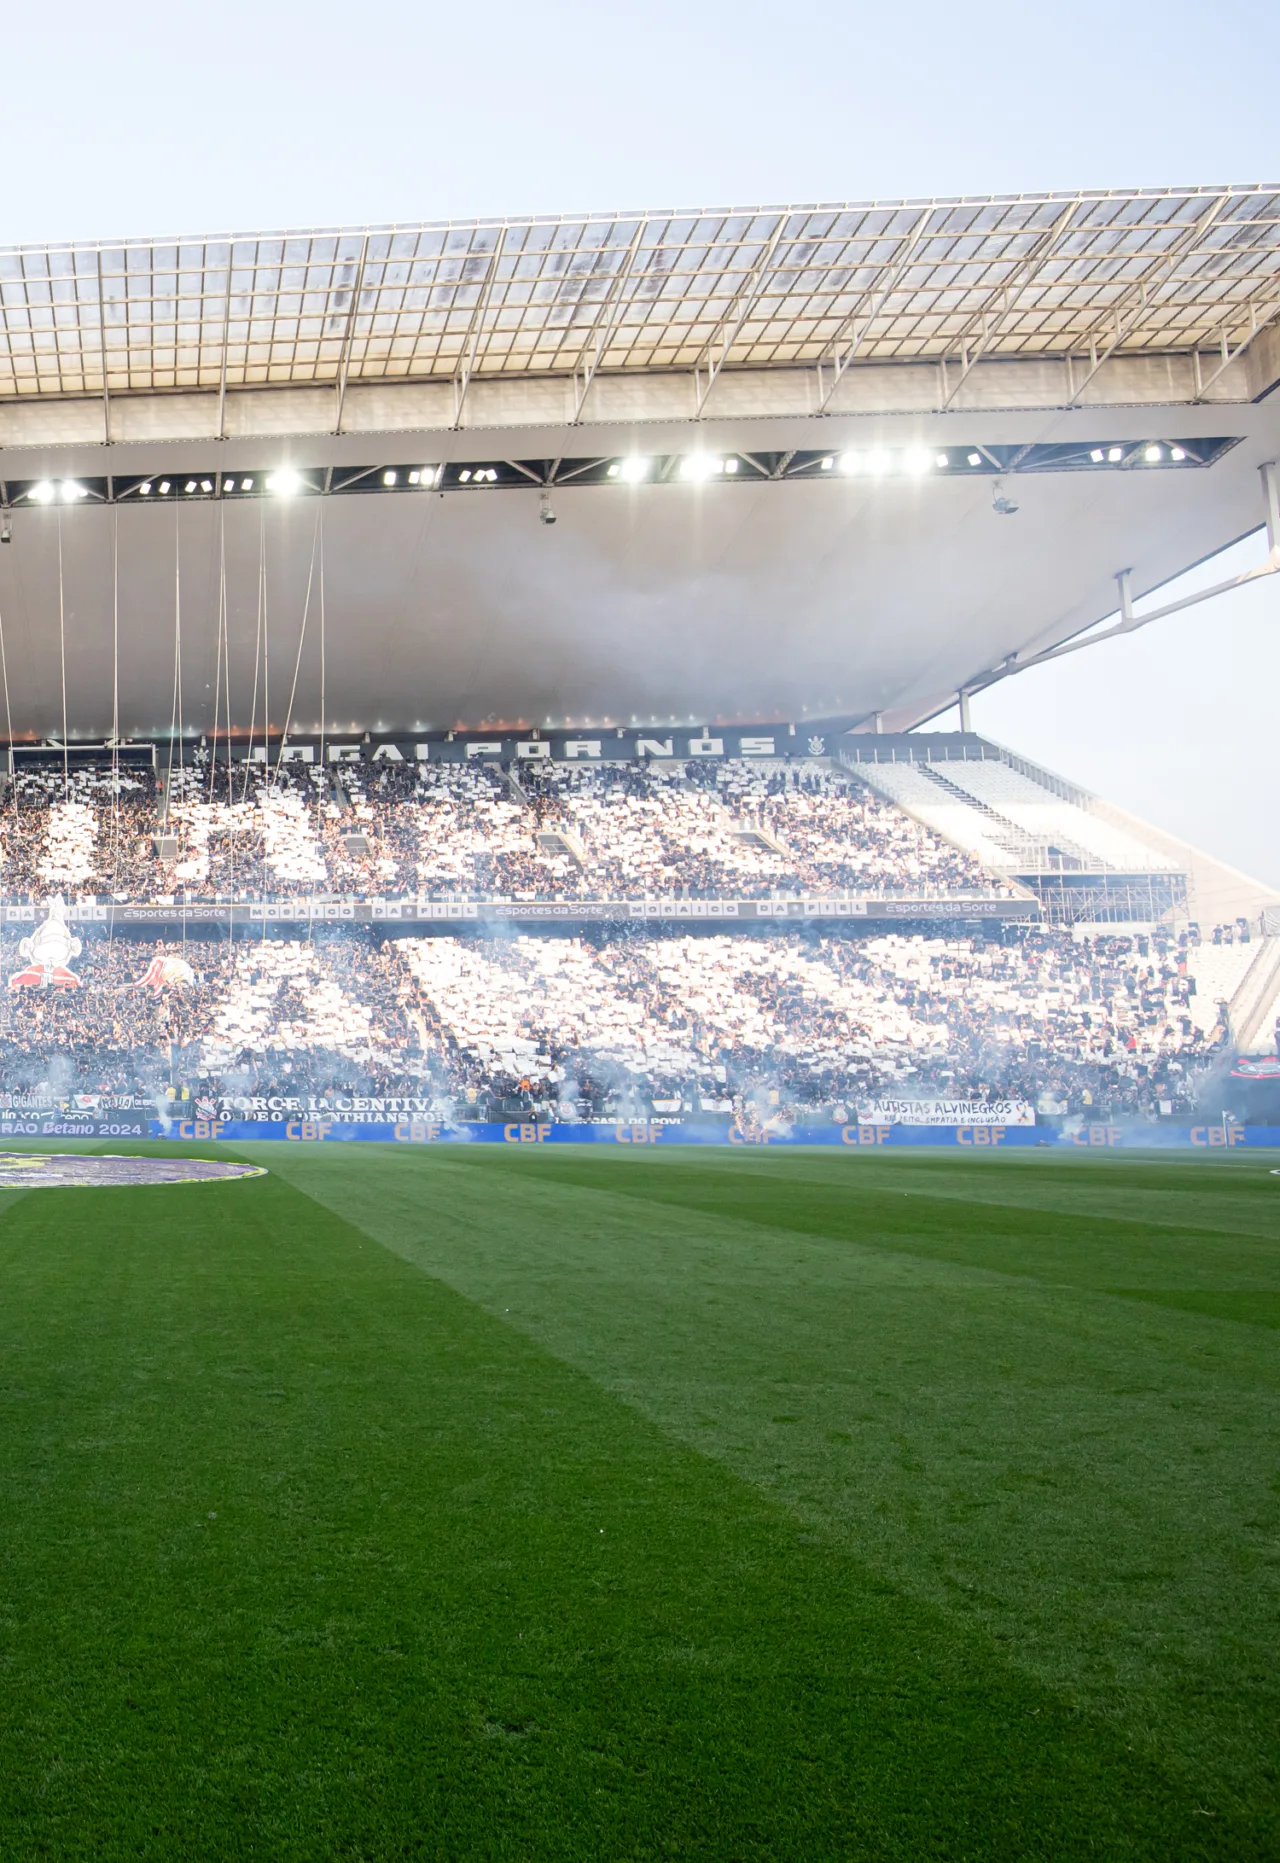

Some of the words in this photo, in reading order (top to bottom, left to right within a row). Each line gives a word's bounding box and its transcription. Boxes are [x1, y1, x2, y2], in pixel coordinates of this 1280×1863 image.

[466, 740, 601, 757] POR
[124, 908, 177, 919] Esportes
[179, 908, 193, 918] da
[194, 908, 226, 918] Sorte
[251, 907, 352, 917] MOSAICO
[420, 906, 475, 915] FIEL
[496, 905, 552, 917] Esportes
[553, 905, 568, 916] da
[569, 905, 603, 915] Sorte
[631, 905, 736, 915] MOSAICO
[808, 903, 863, 913] FIEL
[874, 1100, 930, 1115] AUTISTAS
[935, 1101, 1012, 1115] ALVINEGROS
[286, 1112, 409, 1123] RNTHIANS
[42, 1121, 94, 1135] Betano
[99, 1123, 142, 1135] 2024
[179, 1121, 225, 1139] CBF
[286, 1122, 333, 1141] CBF
[394, 1122, 441, 1141] CBF
[504, 1124, 552, 1143] CBF
[616, 1124, 663, 1143] CBF
[842, 1126, 890, 1145] CBF
[957, 1126, 1006, 1145] CBF
[1073, 1126, 1121, 1146] CBF
[1190, 1126, 1245, 1146] CBF
